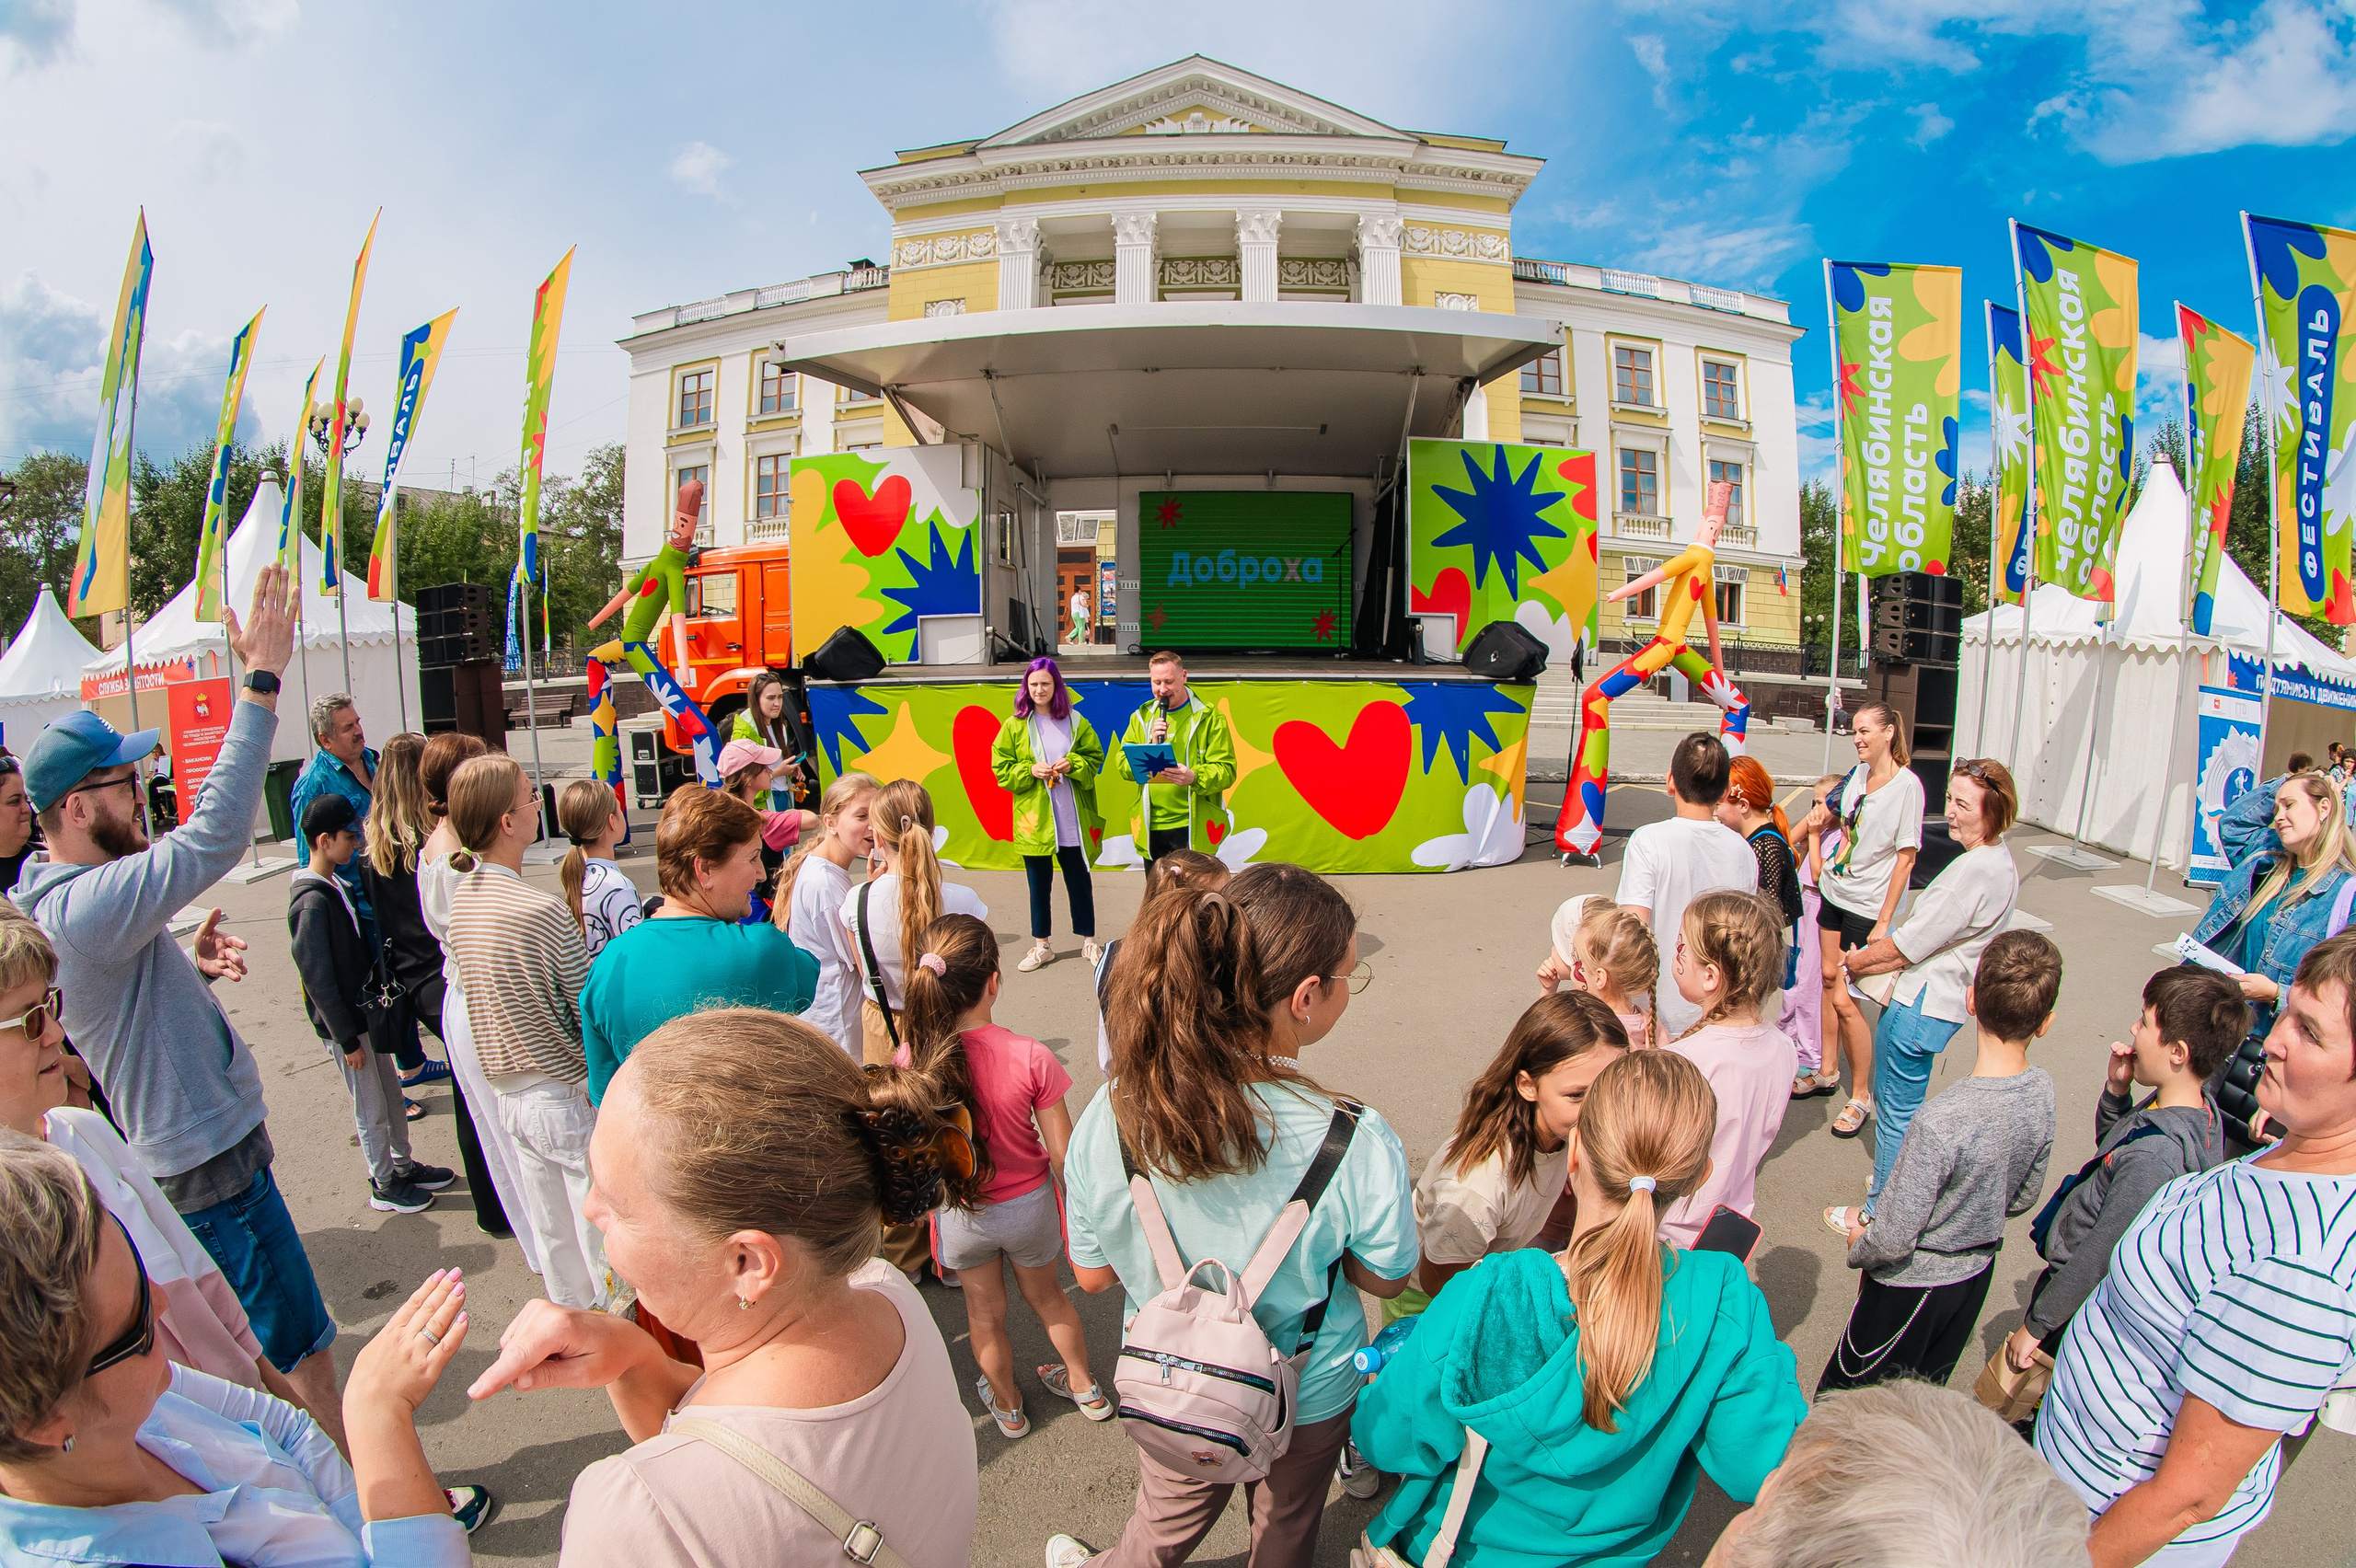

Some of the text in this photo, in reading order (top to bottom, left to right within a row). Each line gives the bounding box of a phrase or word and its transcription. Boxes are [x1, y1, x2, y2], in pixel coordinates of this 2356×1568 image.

[380, 373, 419, 505] ТИВАЛЬ
[1860, 295, 1893, 567] Челябинская
[1894, 402, 1928, 572] область
[2078, 391, 2118, 586] область
[2301, 308, 2330, 580] ФЕСТИВАЛЬ
[1167, 548, 1323, 589] Доброха
[2190, 506, 2212, 614] емья
[98, 679, 124, 696] СЛУЖБА
[2255, 674, 2356, 709] ПДТЯНИСЬ К ДВИЖЕНИ
